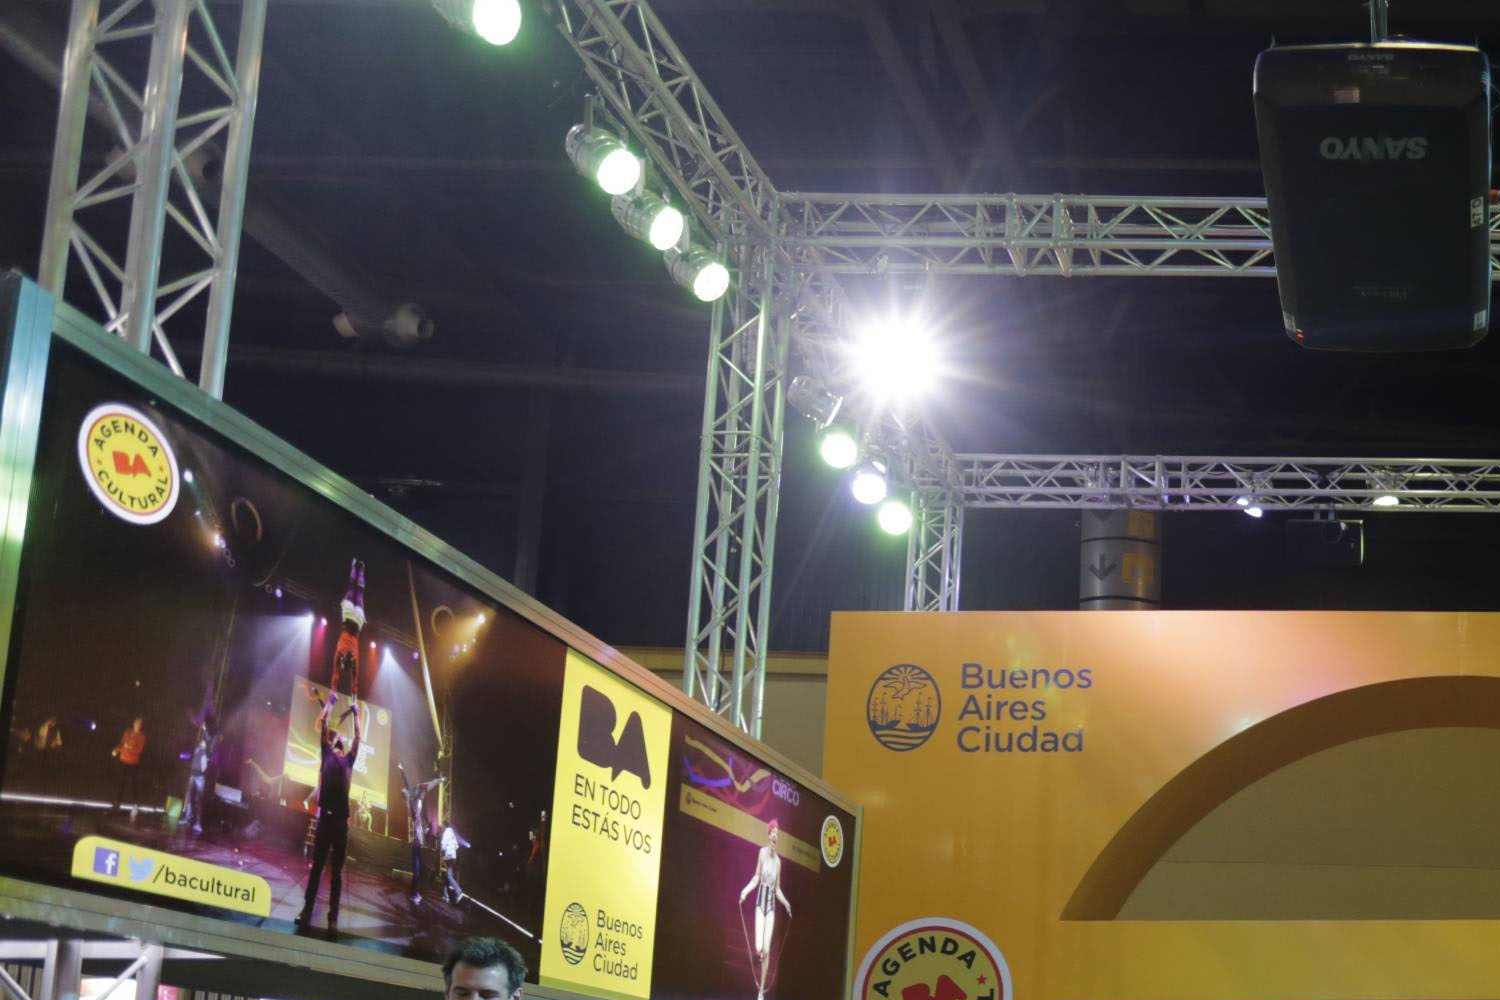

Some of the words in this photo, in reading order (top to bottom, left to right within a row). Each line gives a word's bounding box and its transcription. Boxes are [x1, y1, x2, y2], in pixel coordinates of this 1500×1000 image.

[1319, 137, 1428, 160] SANYO
[94, 420, 158, 457] AGENDA
[98, 470, 168, 509] CULTURAL
[961, 663, 1093, 689] Buenos
[958, 694, 1046, 721] Aires
[956, 725, 1084, 753] Ciudad
[574, 773, 596, 801] EN
[600, 785, 641, 820] TODO
[772, 779, 800, 807] CIRCO
[571, 804, 619, 841] ESTÁS
[623, 824, 652, 854] VOS
[152, 864, 256, 902] /bacultural
[597, 909, 643, 939] Buenos
[594, 932, 626, 956] Aires
[593, 953, 638, 980] Ciudad
[873, 936, 976, 998] AGENDA
